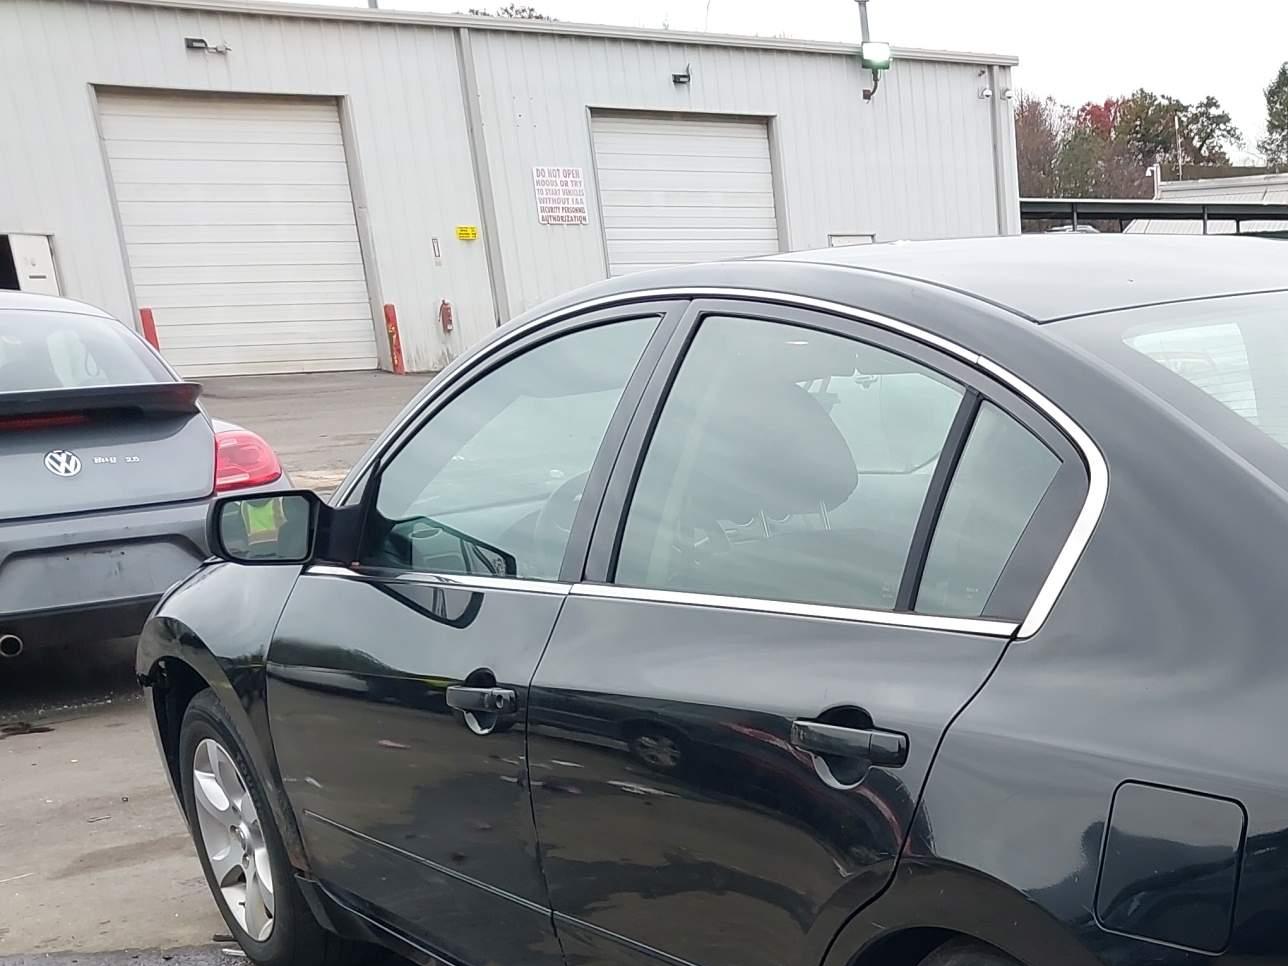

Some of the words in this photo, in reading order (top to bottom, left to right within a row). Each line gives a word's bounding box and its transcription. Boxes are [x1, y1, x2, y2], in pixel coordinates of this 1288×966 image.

[536, 168, 545, 178] DO
[547, 168, 560, 178] NOT
[562, 168, 581, 179] OPEN
[570, 180, 582, 188] TRY
[545, 188, 560, 196] START
[538, 197, 570, 205] WITHOUT
[540, 205, 560, 213] SECURITY
